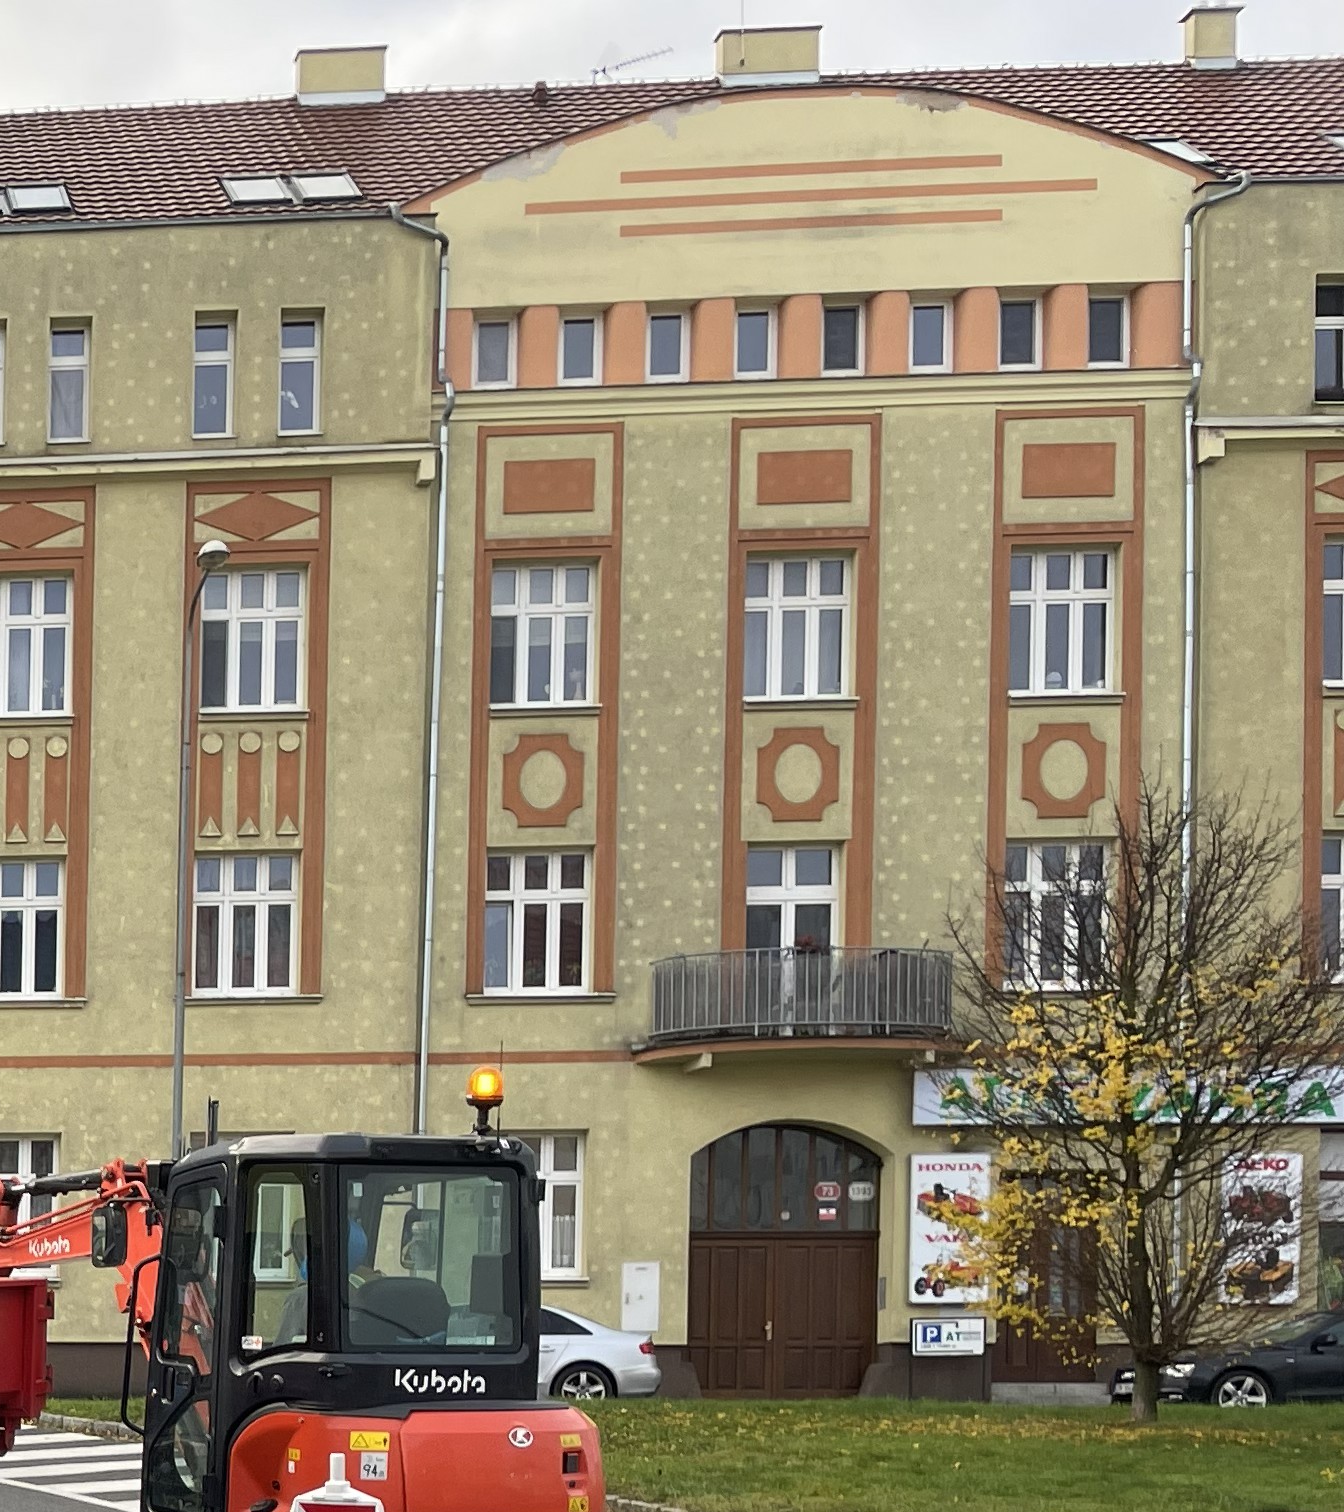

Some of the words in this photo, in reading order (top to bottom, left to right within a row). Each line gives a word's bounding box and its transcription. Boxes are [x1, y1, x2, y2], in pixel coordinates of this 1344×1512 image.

[918, 1163, 984, 1172] HONDA
[28, 1235, 70, 1257] Kubota
[394, 1368, 486, 1394] Kubota
